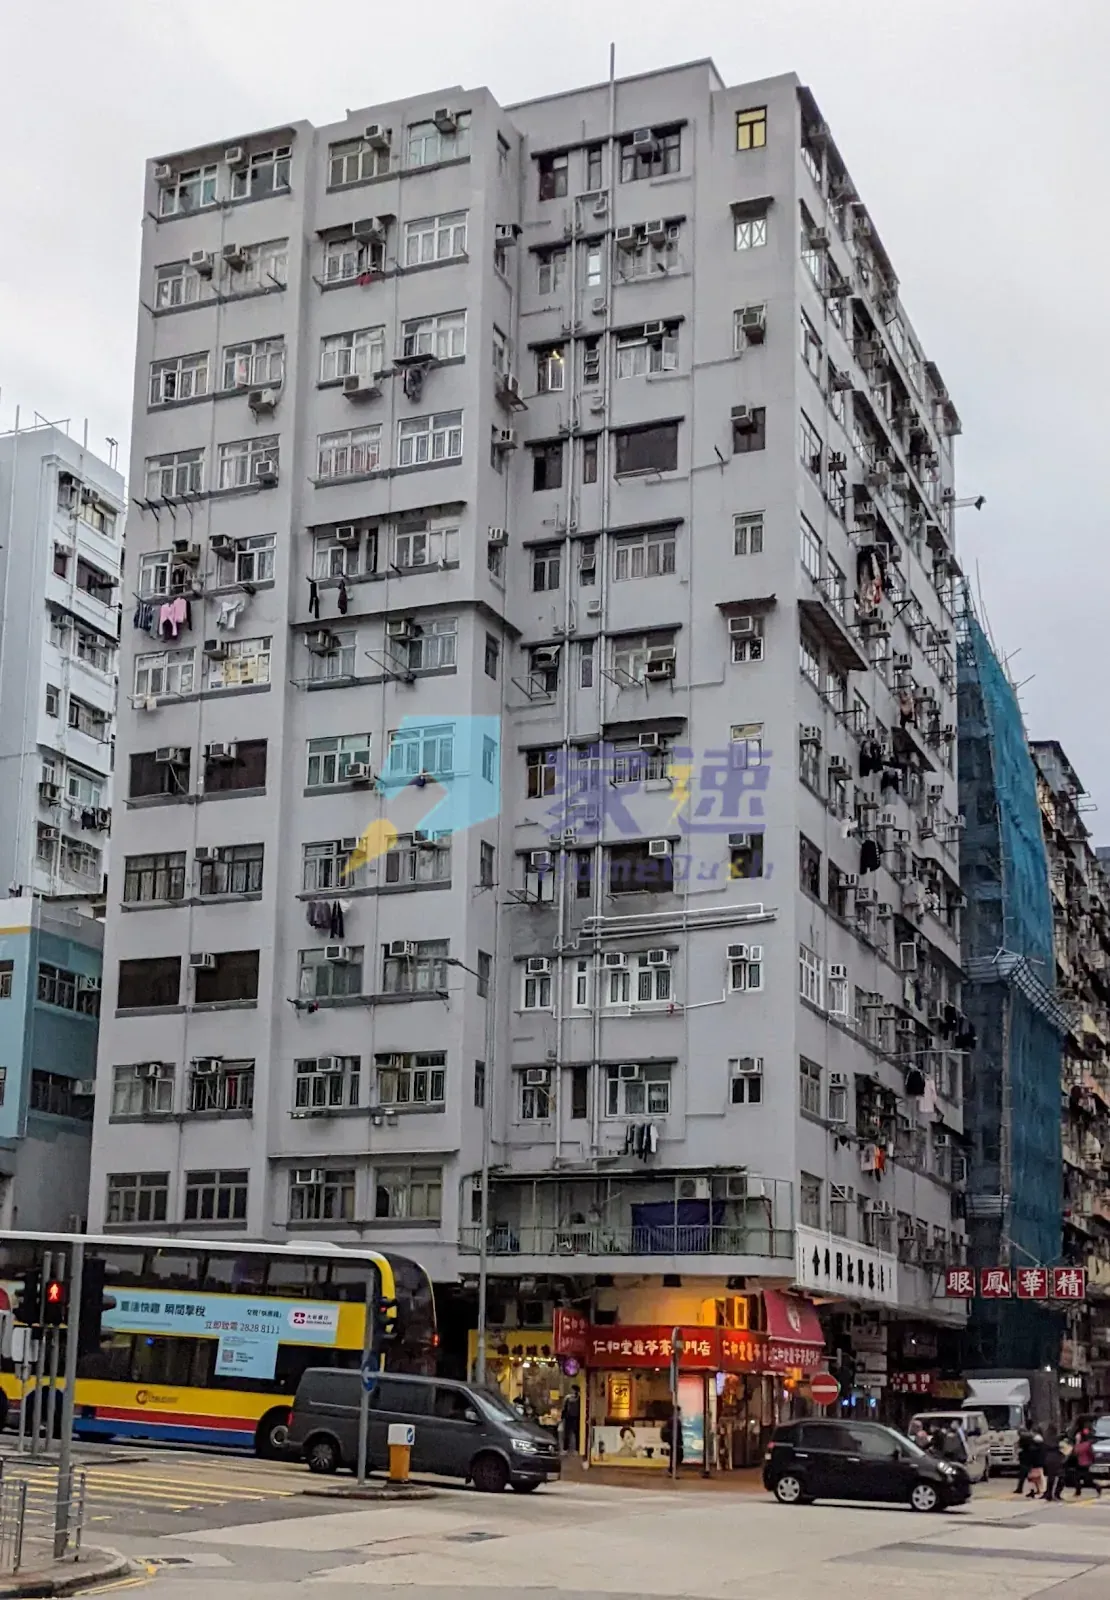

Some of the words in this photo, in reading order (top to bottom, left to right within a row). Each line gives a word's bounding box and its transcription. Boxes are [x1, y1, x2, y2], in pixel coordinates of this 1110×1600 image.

[593, 1339, 711, 1357] 仁和堂龜苓膏門店
